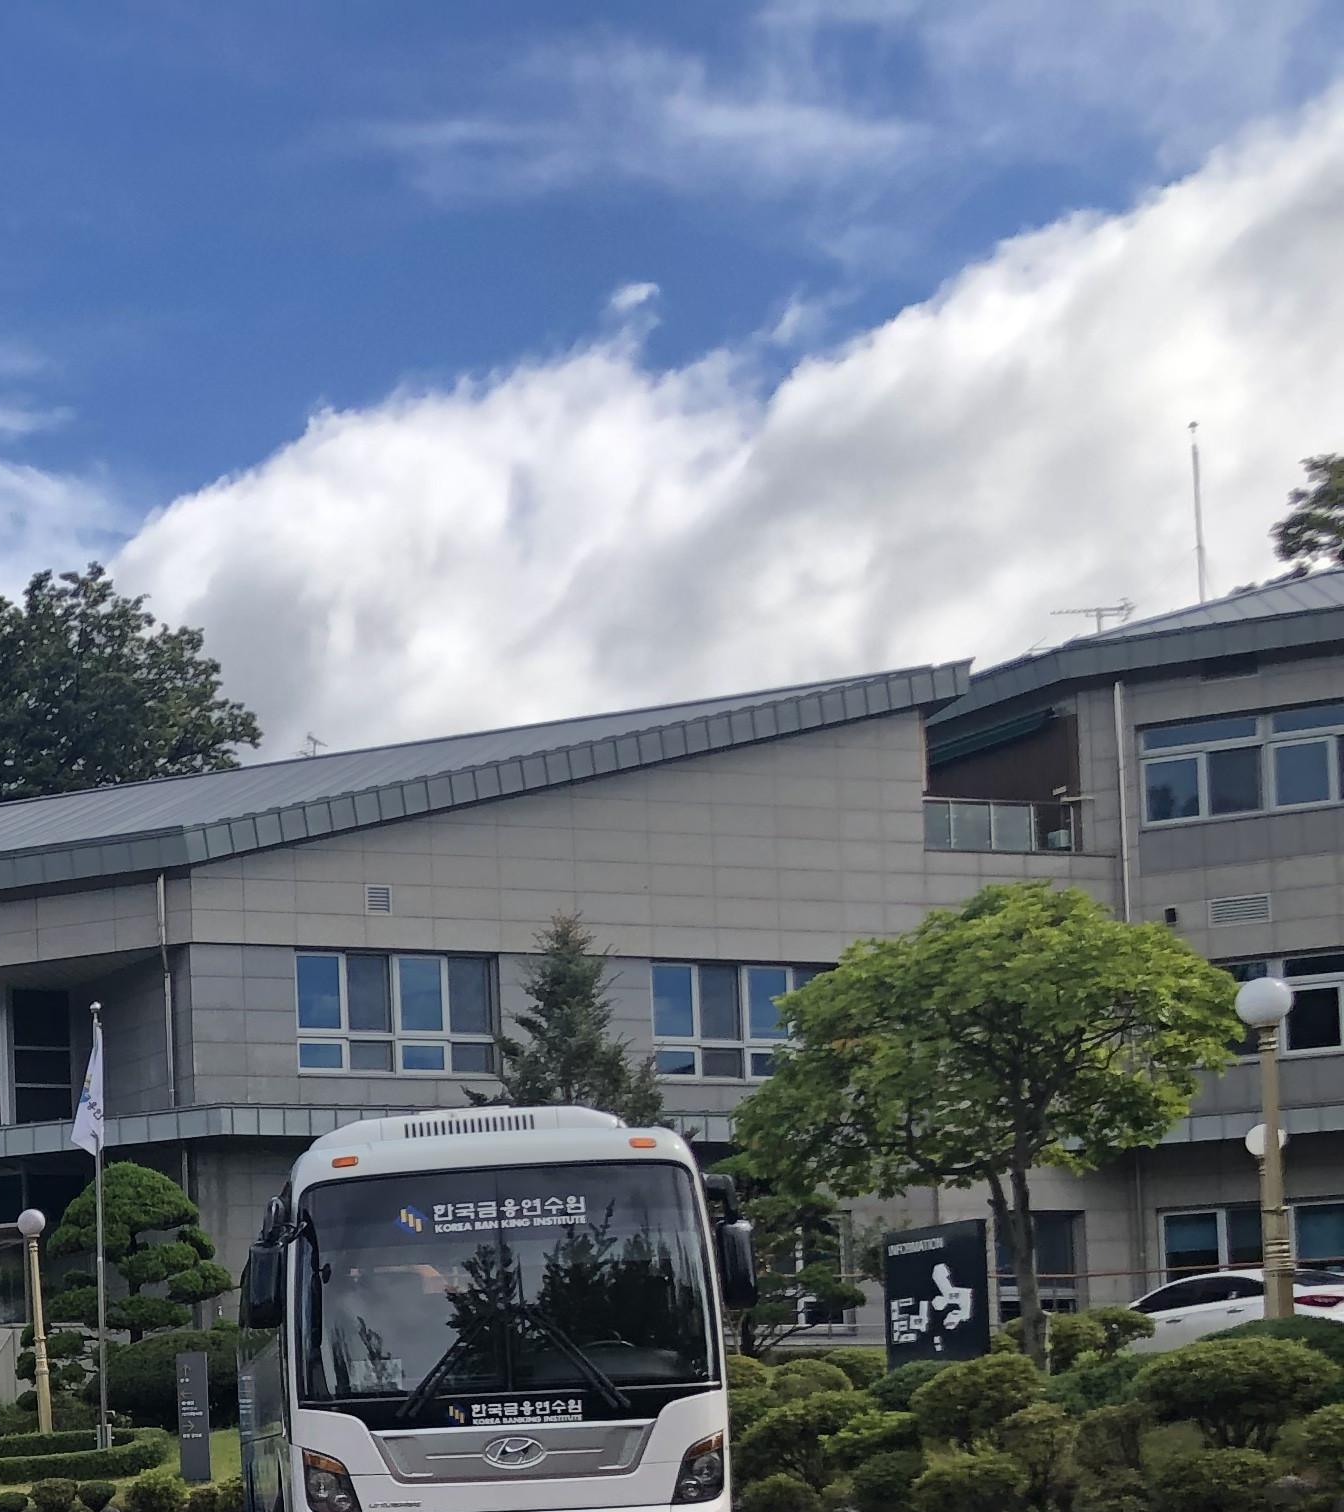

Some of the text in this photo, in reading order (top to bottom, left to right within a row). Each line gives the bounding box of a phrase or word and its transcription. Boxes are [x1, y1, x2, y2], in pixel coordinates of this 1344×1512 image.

[432, 1195, 586, 1222] 한국금융연수원
[434, 1222, 473, 1233] KOREA
[533, 1215, 586, 1226] INSTITUTE
[471, 1399, 582, 1417] 한국금융연수원
